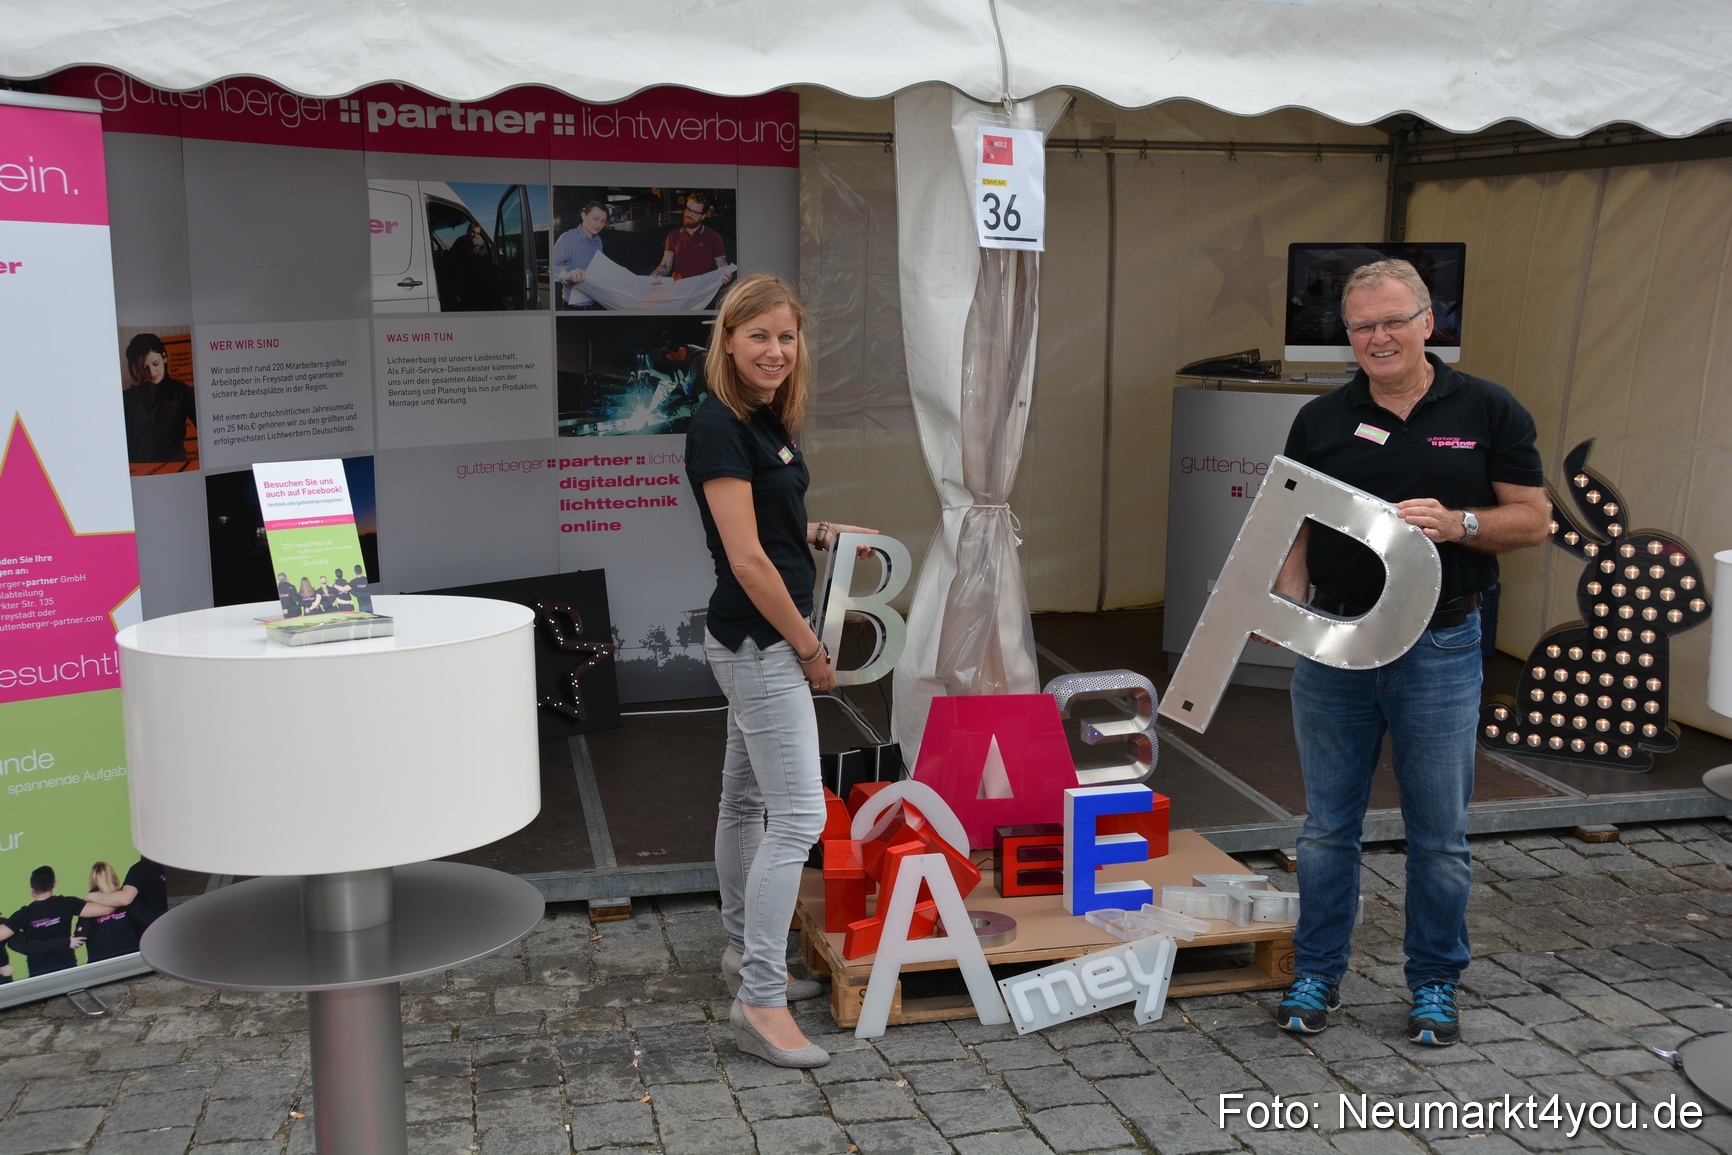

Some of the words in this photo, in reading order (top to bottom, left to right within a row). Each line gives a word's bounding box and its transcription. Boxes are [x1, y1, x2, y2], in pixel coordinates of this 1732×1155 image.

[367, 101, 545, 134] partner
[582, 106, 795, 152] lichtwerbung
[982, 192, 1021, 231] 36
[210, 341, 232, 350] WER
[235, 340, 253, 349] WIR
[257, 339, 279, 348] SIND
[387, 334, 408, 342] WAS
[412, 333, 430, 342] WIR
[434, 333, 453, 341] TUN
[388, 356, 436, 364] Lichtwerbung
[474, 353, 517, 361] Leidenschaft.
[225, 366, 239, 374] sind
[241, 365, 252, 373] mit
[272, 363, 284, 371] 220
[286, 361, 323, 370] Mitarbeitern
[401, 365, 490, 374] Full-Service-Dienstleister
[492, 363, 523, 371] kümmern
[211, 377, 252, 387] Arbeitgeber
[263, 375, 293, 384] Freystadt
[308, 371, 343, 381] garantieren
[432, 376, 465, 385] gesamten
[212, 388, 237, 398] sichere
[239, 387, 284, 396] Arbeitsplätze
[306, 383, 328, 393] Region.
[389, 389, 420, 397] Beratung
[438, 387, 466, 395] Planung
[389, 399, 419, 408] Montage
[436, 397, 468, 405] Wartung.
[213, 414, 223, 422] Mit
[226, 413, 247, 421] einem
[249, 407, 310, 419] durchschnittlichen
[312, 403, 353, 413] Jahresumsatz
[258, 421, 285, 431] gehören
[321, 415, 344, 425] größten
[214, 434, 265, 446] erfolgreichsten
[267, 430, 310, 439] Lichtwerbern
[312, 425, 355, 435] Deutschlands.
[457, 458, 545, 479] guttenberger
[559, 454, 633, 470] partner
[1181, 455, 1270, 475] guttenbe
[559, 473, 681, 491] digitaldruck
[266, 490, 285, 498] auch
[302, 486, 342, 495] Facebook!
[560, 495, 679, 511] lichttechnik
[560, 519, 621, 533] online
[20, 556, 33, 564] Sie
[60, 574, 86, 583] GmbH
[1157, 454, 1443, 733] P
[22, 600, 37, 608] Str.
[817, 532, 912, 687] B
[0, 749, 55, 776] nde
[911, 694, 1080, 851] A
[8, 773, 80, 796] spannende
[1063, 783, 1154, 916] E
[855, 852, 1010, 1039] A
[1011, 935, 1172, 1023] mey
